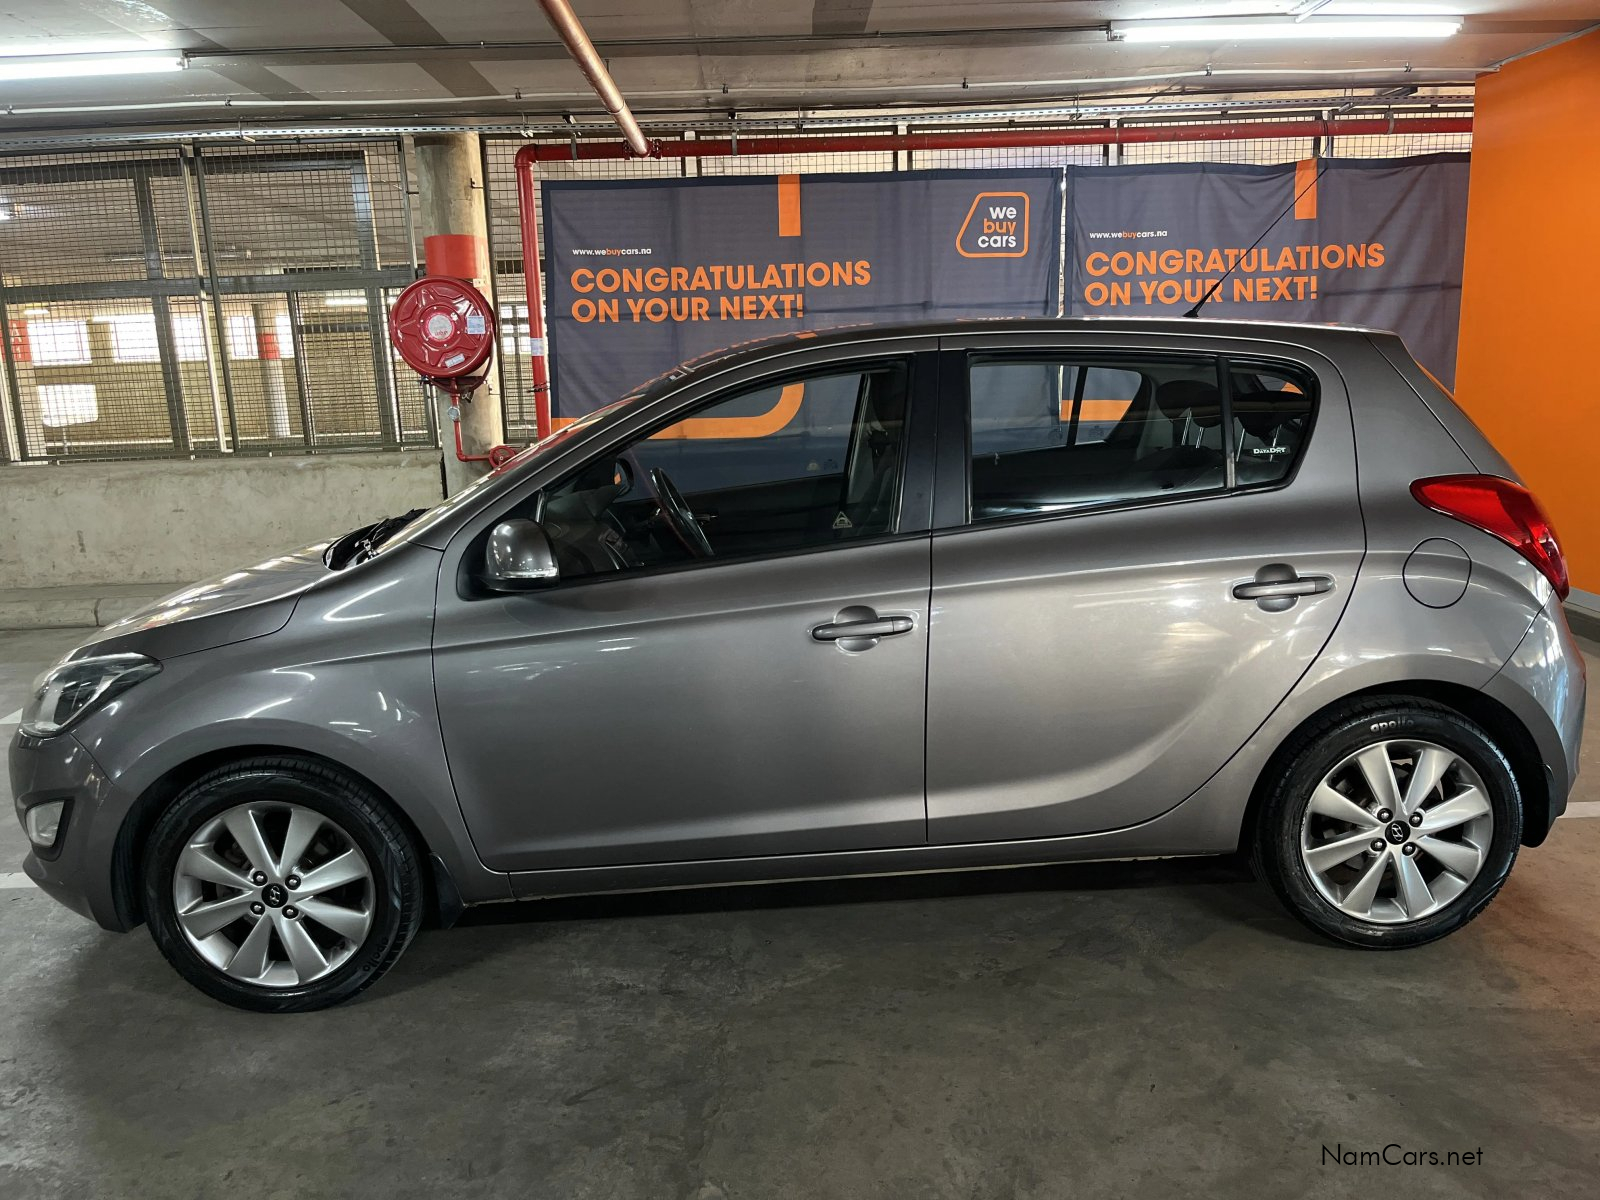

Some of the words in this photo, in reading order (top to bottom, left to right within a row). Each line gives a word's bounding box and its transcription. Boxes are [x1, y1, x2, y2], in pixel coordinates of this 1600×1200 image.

[989, 206, 1017, 219] we
[983, 218, 1017, 235] buy
[1089, 230, 1168, 240] www.webuycars.na
[977, 235, 1017, 248] cars
[572, 248, 652, 257] www.webuycars.na
[1085, 243, 1386, 277] CONGRATULATIONS
[570, 260, 871, 293] CONGRATULATIONS
[1084, 281, 1131, 306] ON
[1138, 278, 1223, 305] YOUR
[1233, 275, 1318, 302] NEXT!
[571, 298, 619, 323] ON
[626, 296, 711, 323] YOUR
[719, 293, 804, 321] NEXT!
[1370, 716, 1414, 734] apollo
